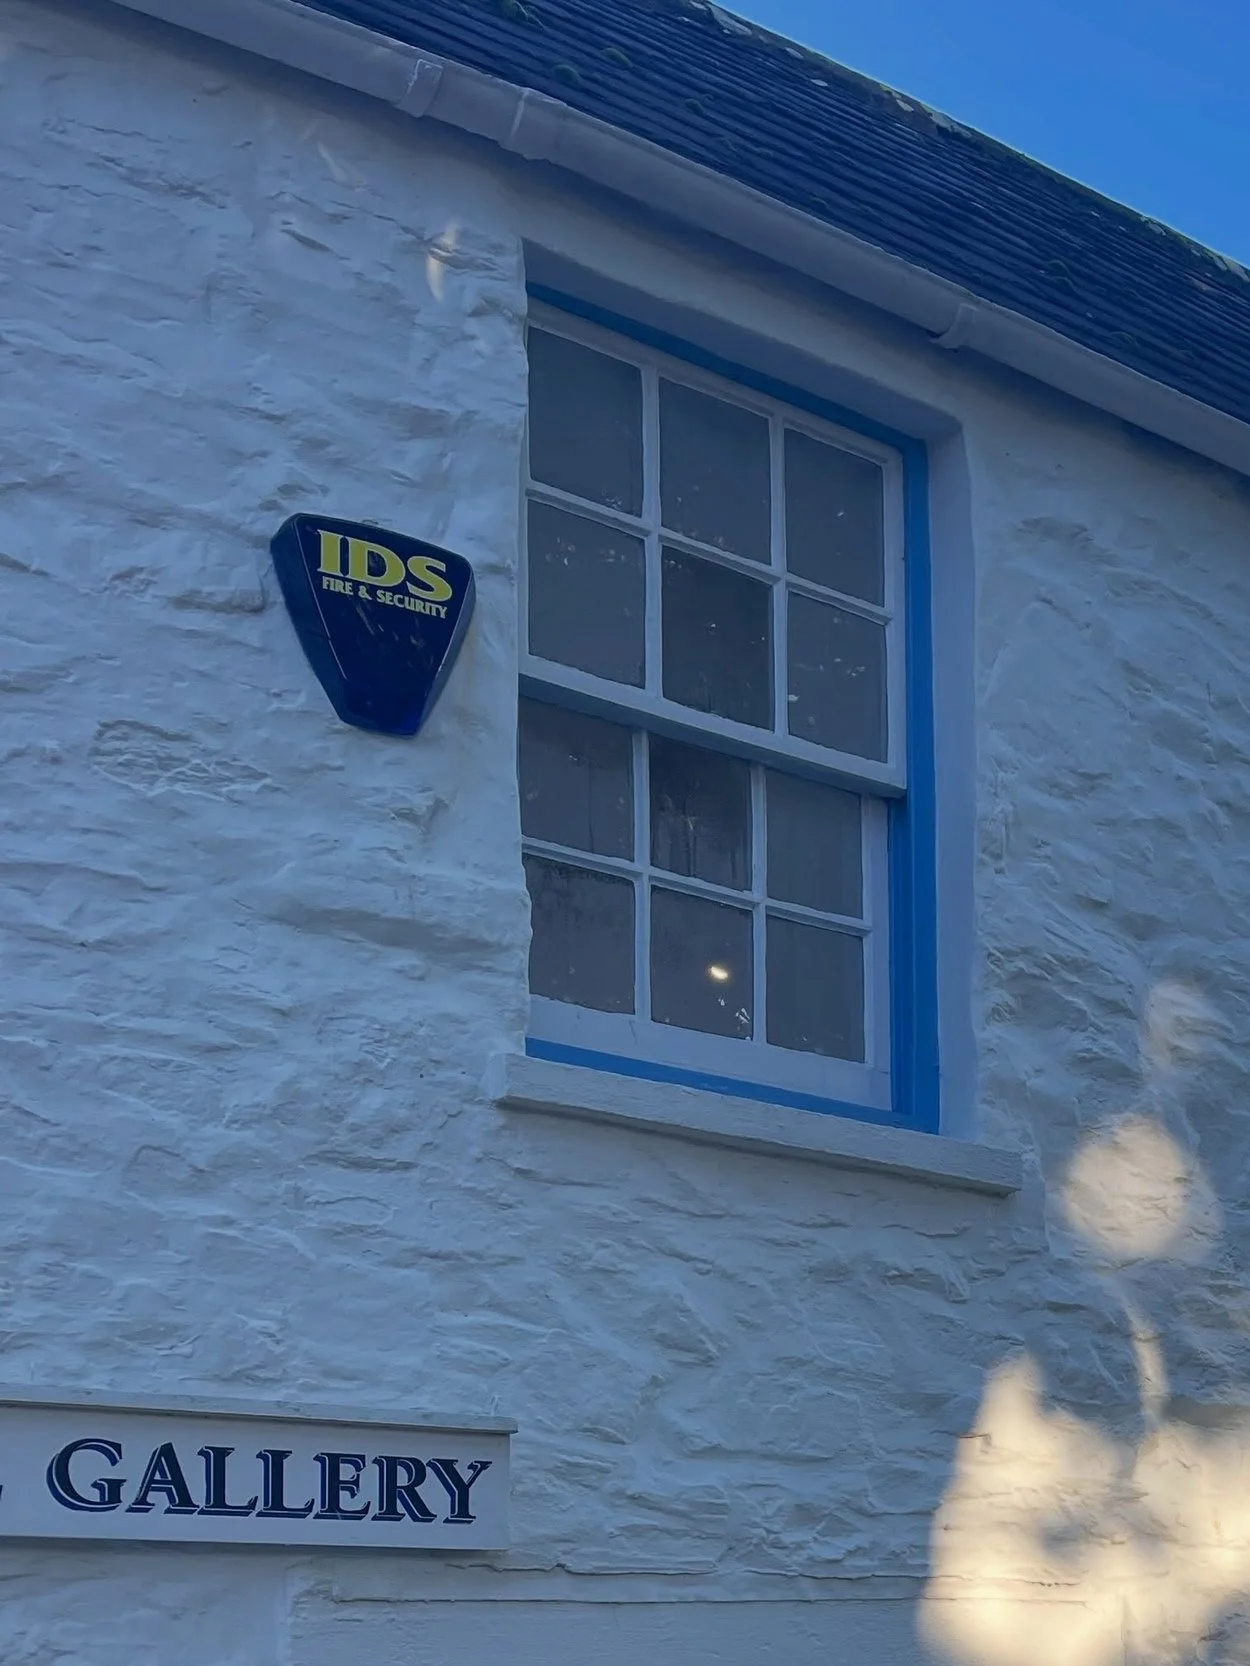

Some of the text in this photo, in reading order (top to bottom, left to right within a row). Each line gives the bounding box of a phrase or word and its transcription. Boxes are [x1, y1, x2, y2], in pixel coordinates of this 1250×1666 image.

[316, 529, 453, 602] IDS
[322, 576, 448, 619] FIRE & SECURITY
[46, 1437, 493, 1525] GALLERY
